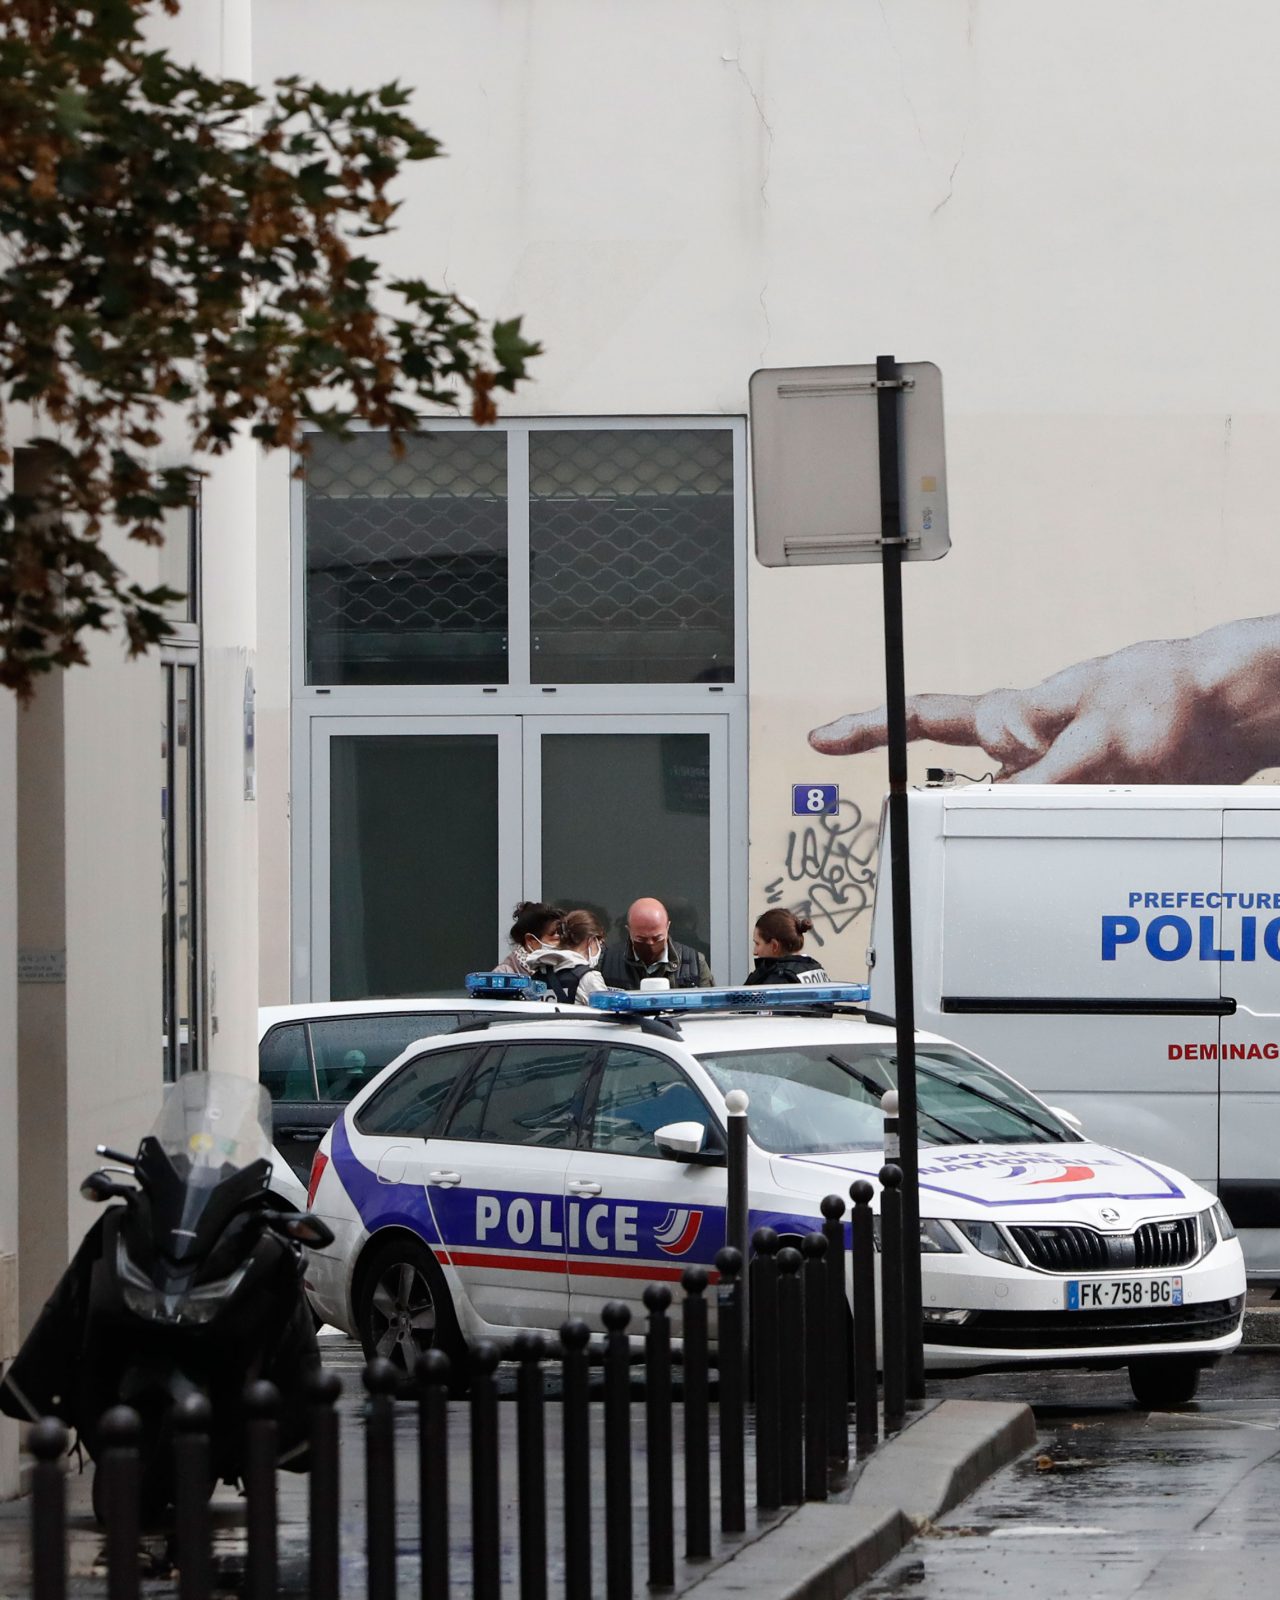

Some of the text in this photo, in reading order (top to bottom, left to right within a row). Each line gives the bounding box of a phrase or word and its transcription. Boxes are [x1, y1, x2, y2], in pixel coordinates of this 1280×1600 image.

[806, 788, 825, 812] 8
[918, 1157, 1124, 1176] NATIONALE
[933, 1150, 1062, 1163] POLICE
[475, 1196, 638, 1252] POLICE
[1081, 1280, 1170, 1306] FK-758-BG
